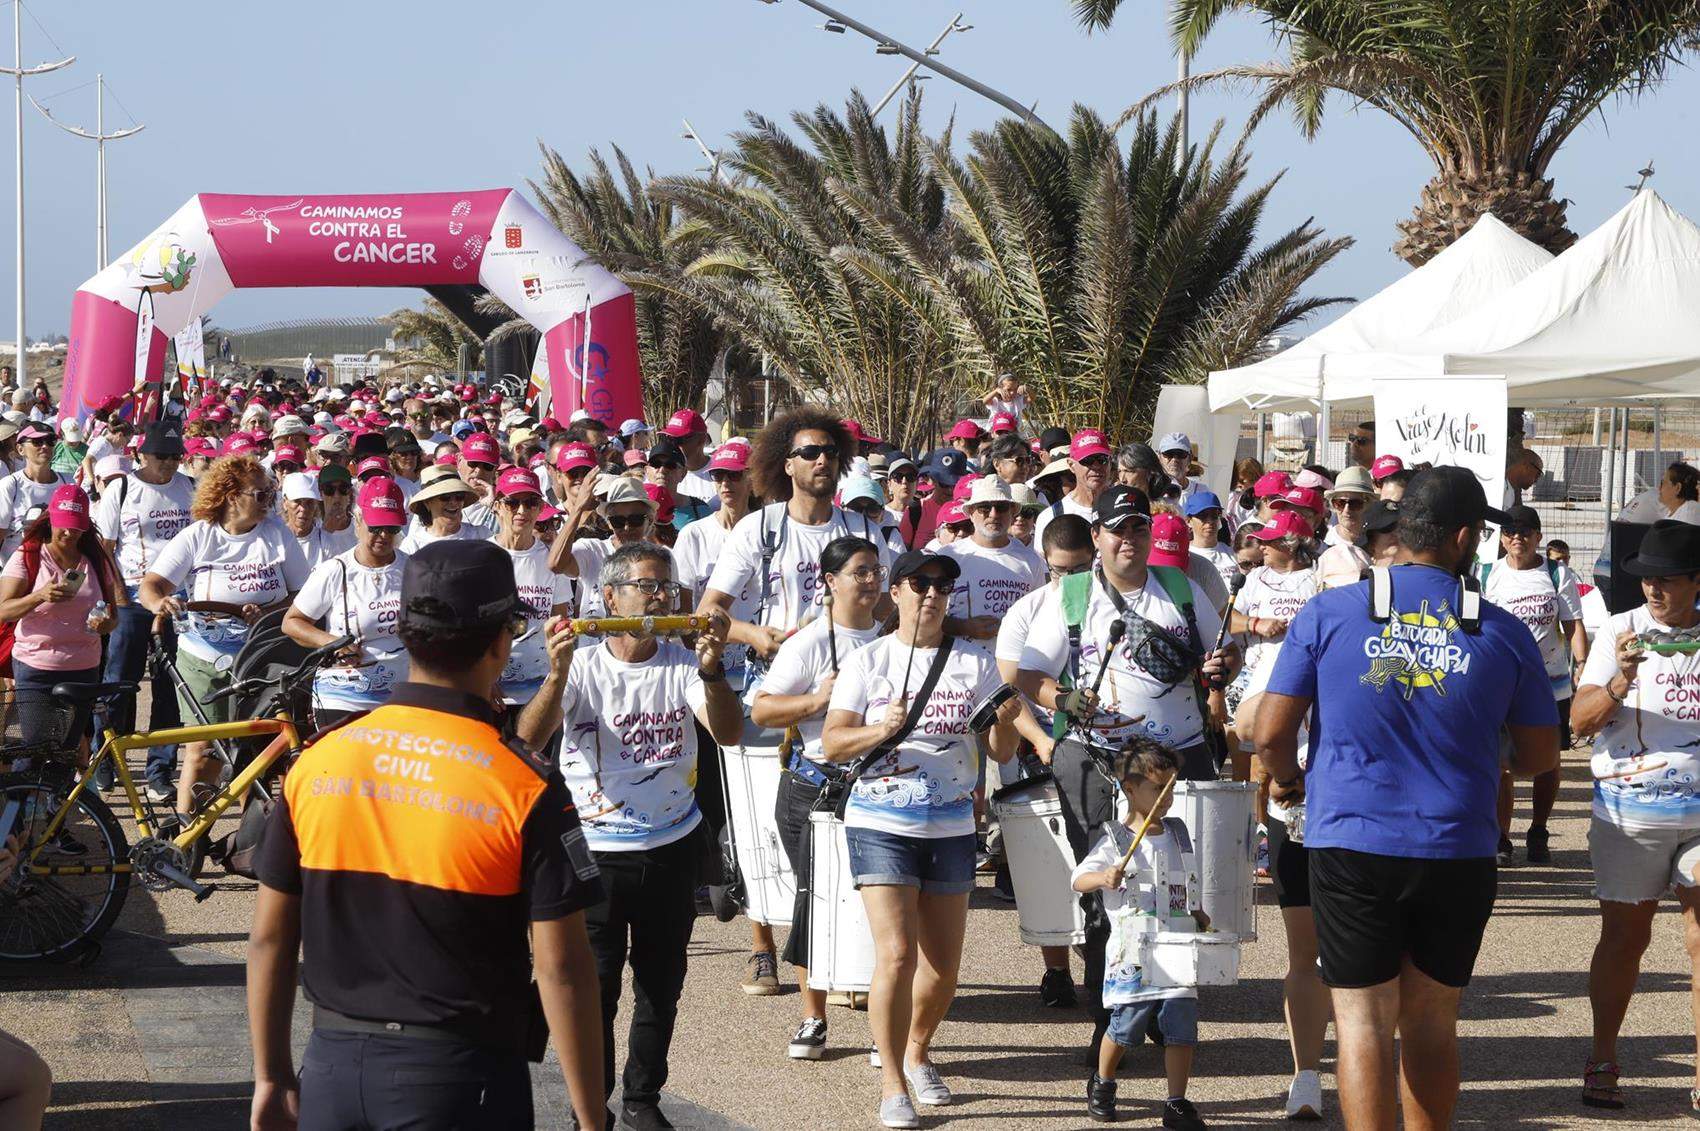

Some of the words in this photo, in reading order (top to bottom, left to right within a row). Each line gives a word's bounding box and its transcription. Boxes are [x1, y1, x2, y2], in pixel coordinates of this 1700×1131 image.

[300, 205, 403, 219] CAMINAMOS
[309, 221, 381, 238] CONTRA
[386, 223, 408, 239] EL
[333, 241, 437, 265] CANCER
[978, 579, 1031, 592] CAMINAMOS
[1512, 603, 1554, 616] CONTRA
[1391, 622, 1448, 647] BATUCADA
[613, 705, 687, 728] CAMINAMOS
[621, 726, 684, 746] CONTRA
[619, 750, 632, 761] EL
[373, 753, 435, 783] CIVIL
[311, 776, 354, 797] SAN
[360, 777, 503, 826] BARTOLOME
